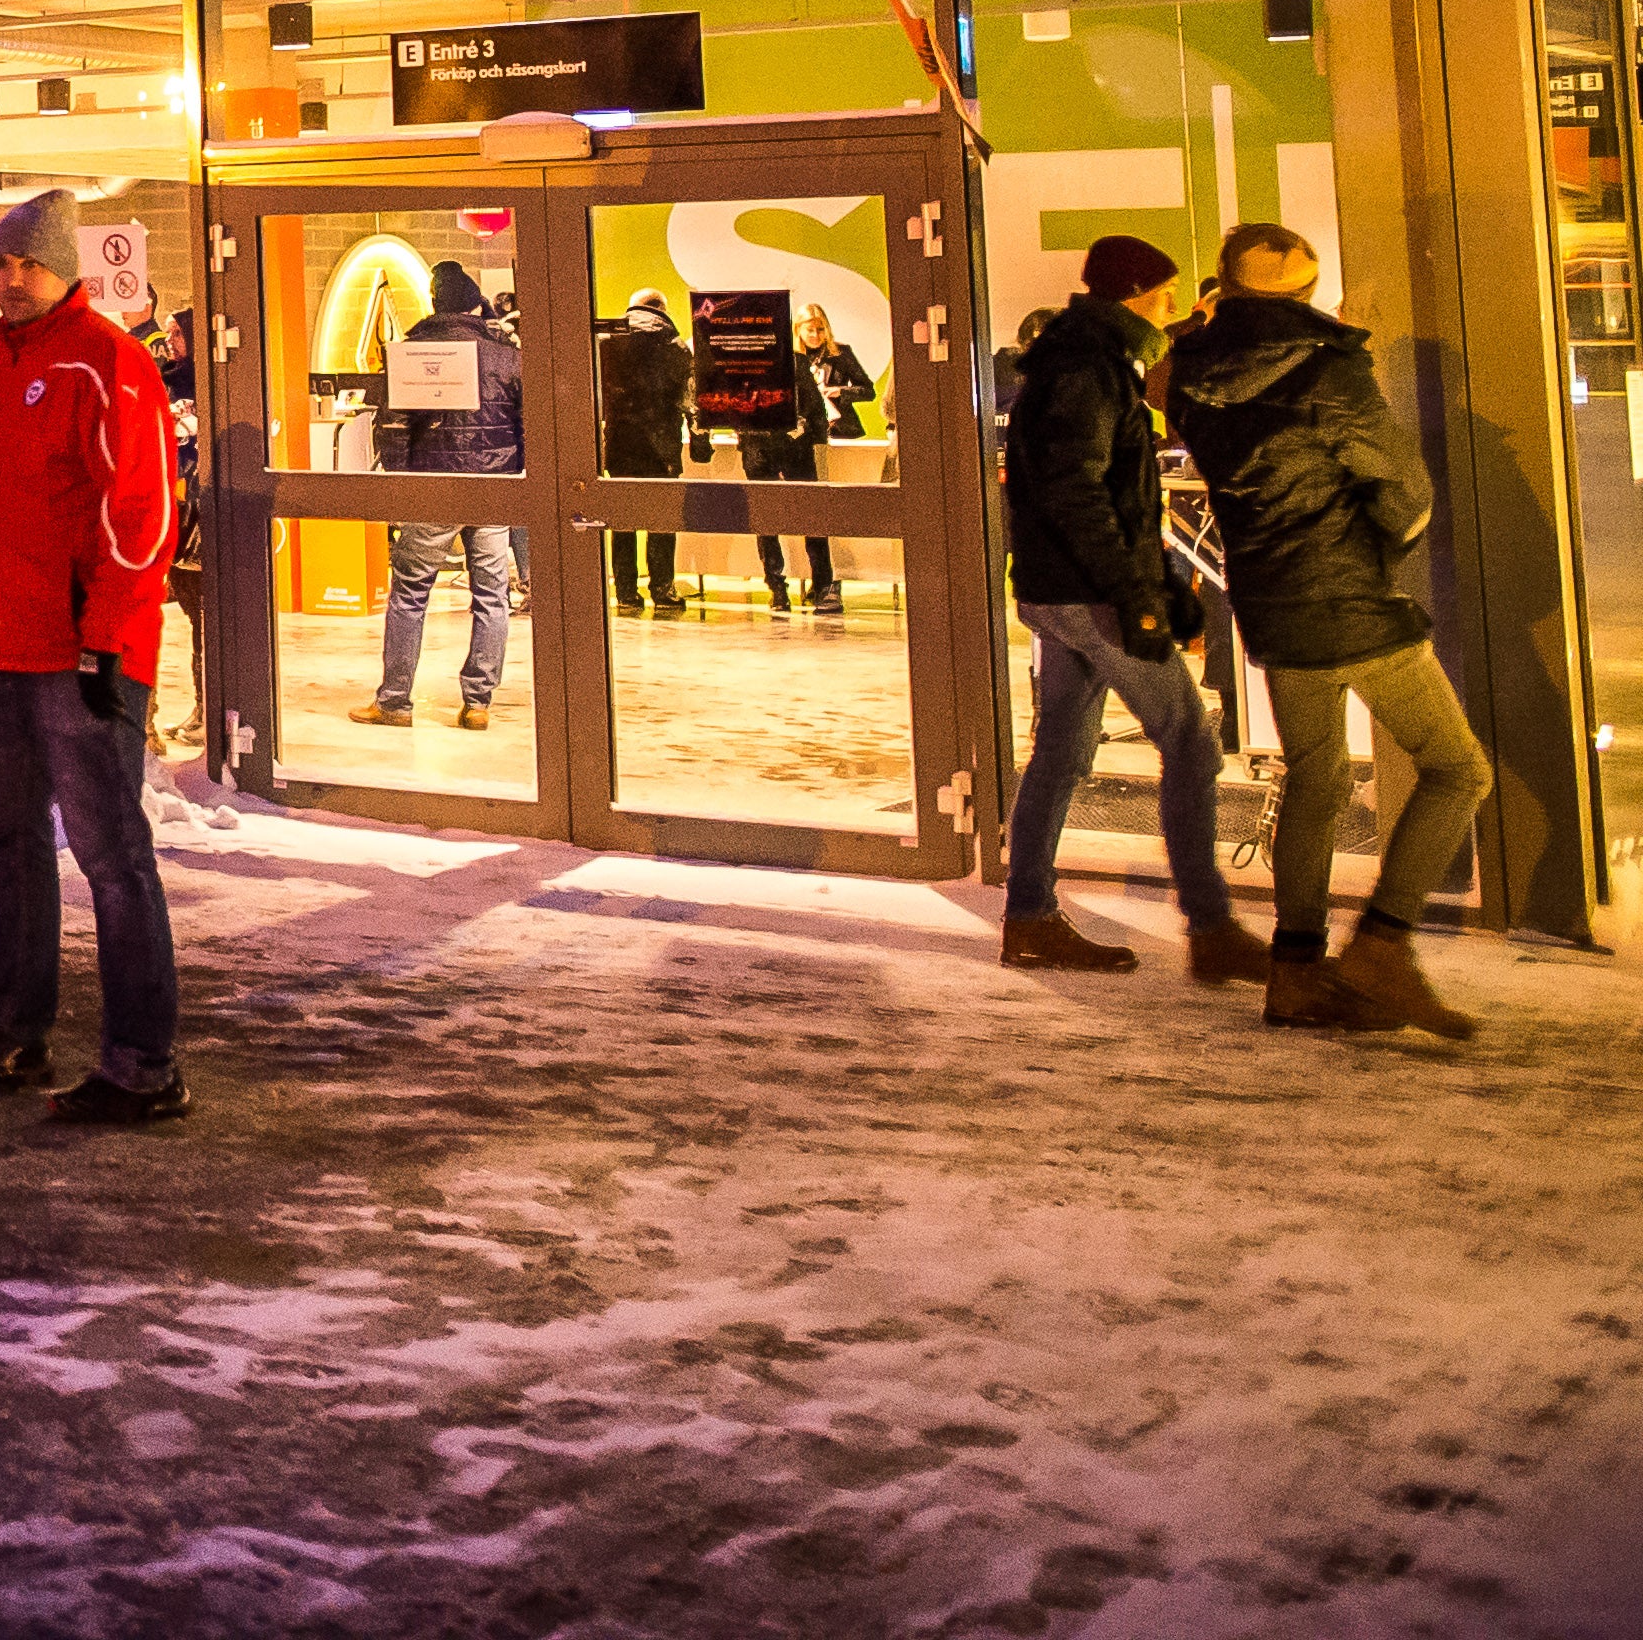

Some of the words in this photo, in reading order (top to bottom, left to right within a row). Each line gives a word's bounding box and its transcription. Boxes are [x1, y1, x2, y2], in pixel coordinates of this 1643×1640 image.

[429, 41, 479, 61] Entré
[482, 40, 495, 58] 3
[430, 65, 477, 82] Förköp
[478, 63, 504, 79] och
[505, 59, 587, 79] säsongskort
